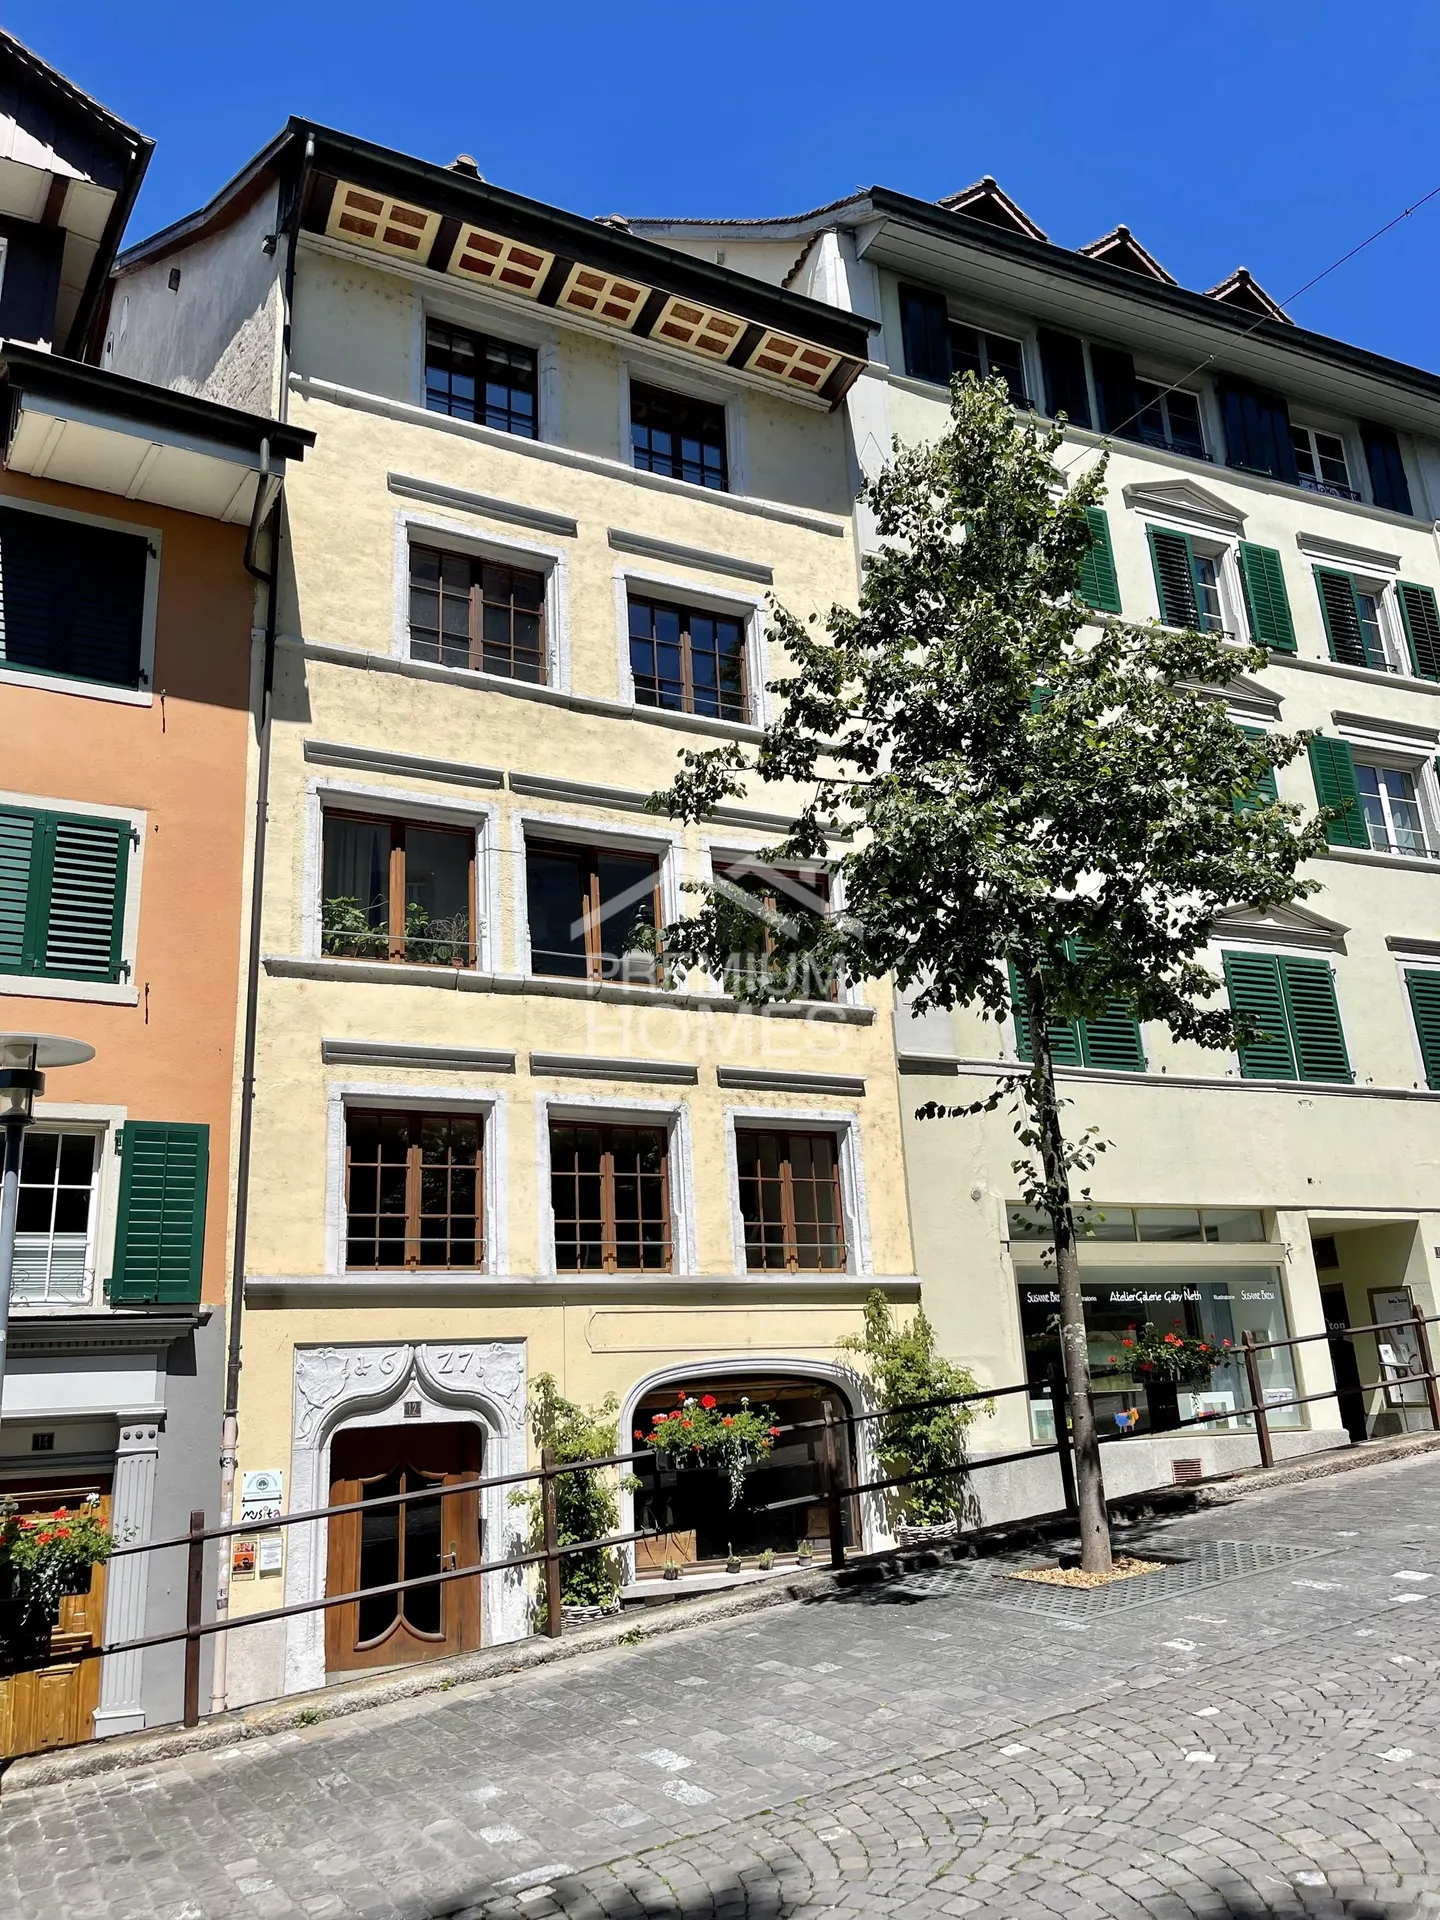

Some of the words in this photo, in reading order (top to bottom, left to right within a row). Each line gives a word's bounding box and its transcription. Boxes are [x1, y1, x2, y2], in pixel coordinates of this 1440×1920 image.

[1164, 1290, 1183, 1303] Gaby
[1183, 1288, 1202, 1301] Neth
[407, 1402, 418, 1416] 12
